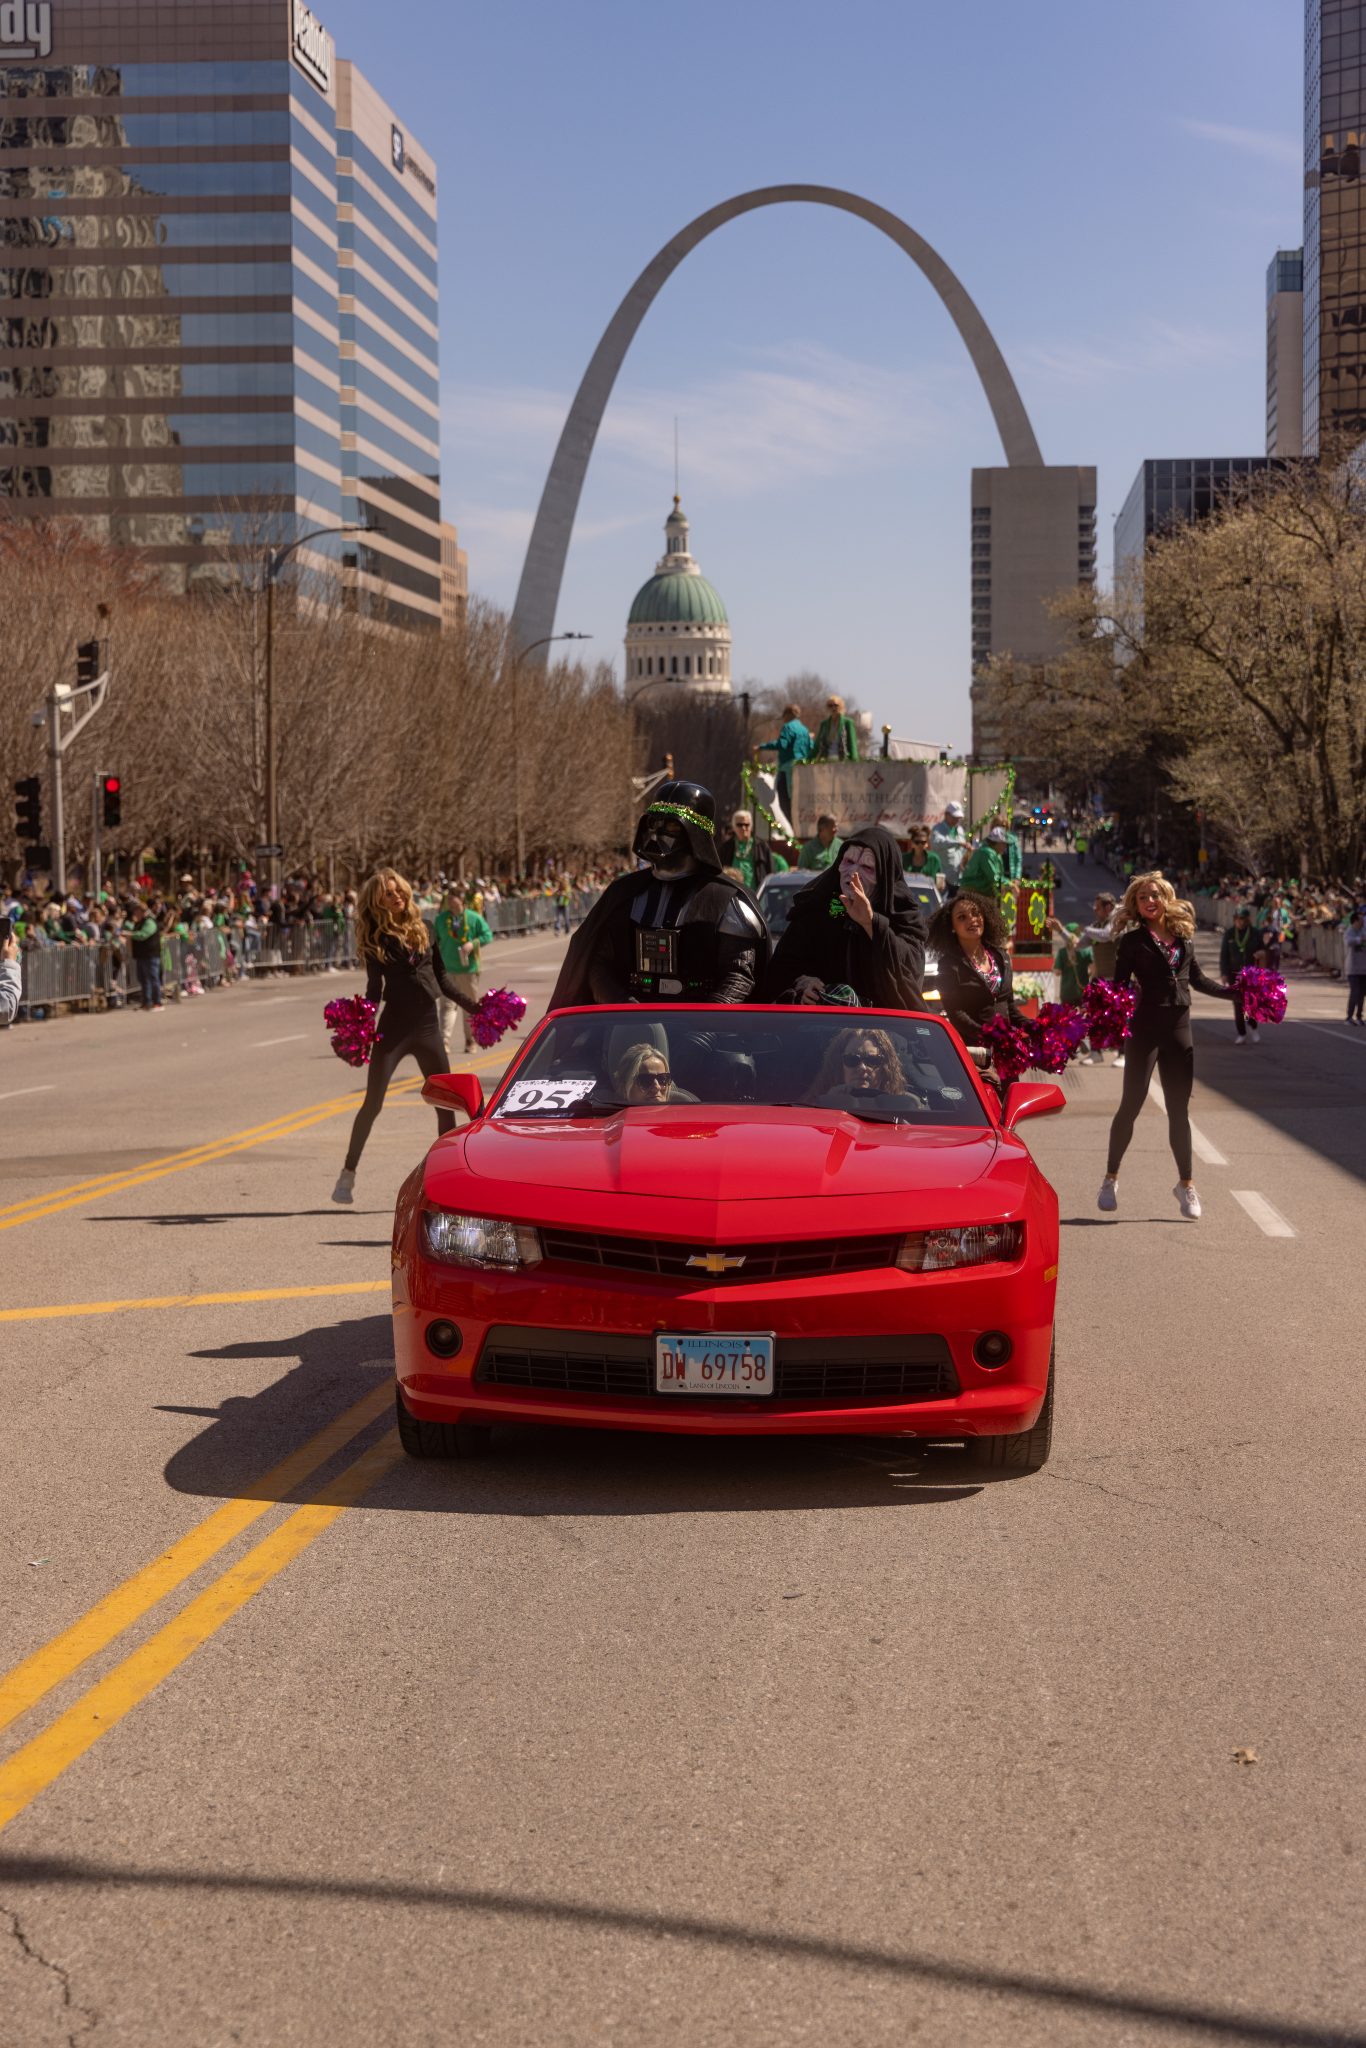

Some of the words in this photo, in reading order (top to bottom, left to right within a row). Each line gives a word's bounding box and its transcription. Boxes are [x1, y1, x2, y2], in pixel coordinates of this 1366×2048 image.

[517, 1089, 573, 1111] 95
[687, 1340, 743, 1348] ILLINOIS
[662, 1352, 687, 1380] DW
[701, 1353, 766, 1381] 69758
[689, 1381, 706, 1389] LAND
[715, 1382, 740, 1390] LINCOLN
